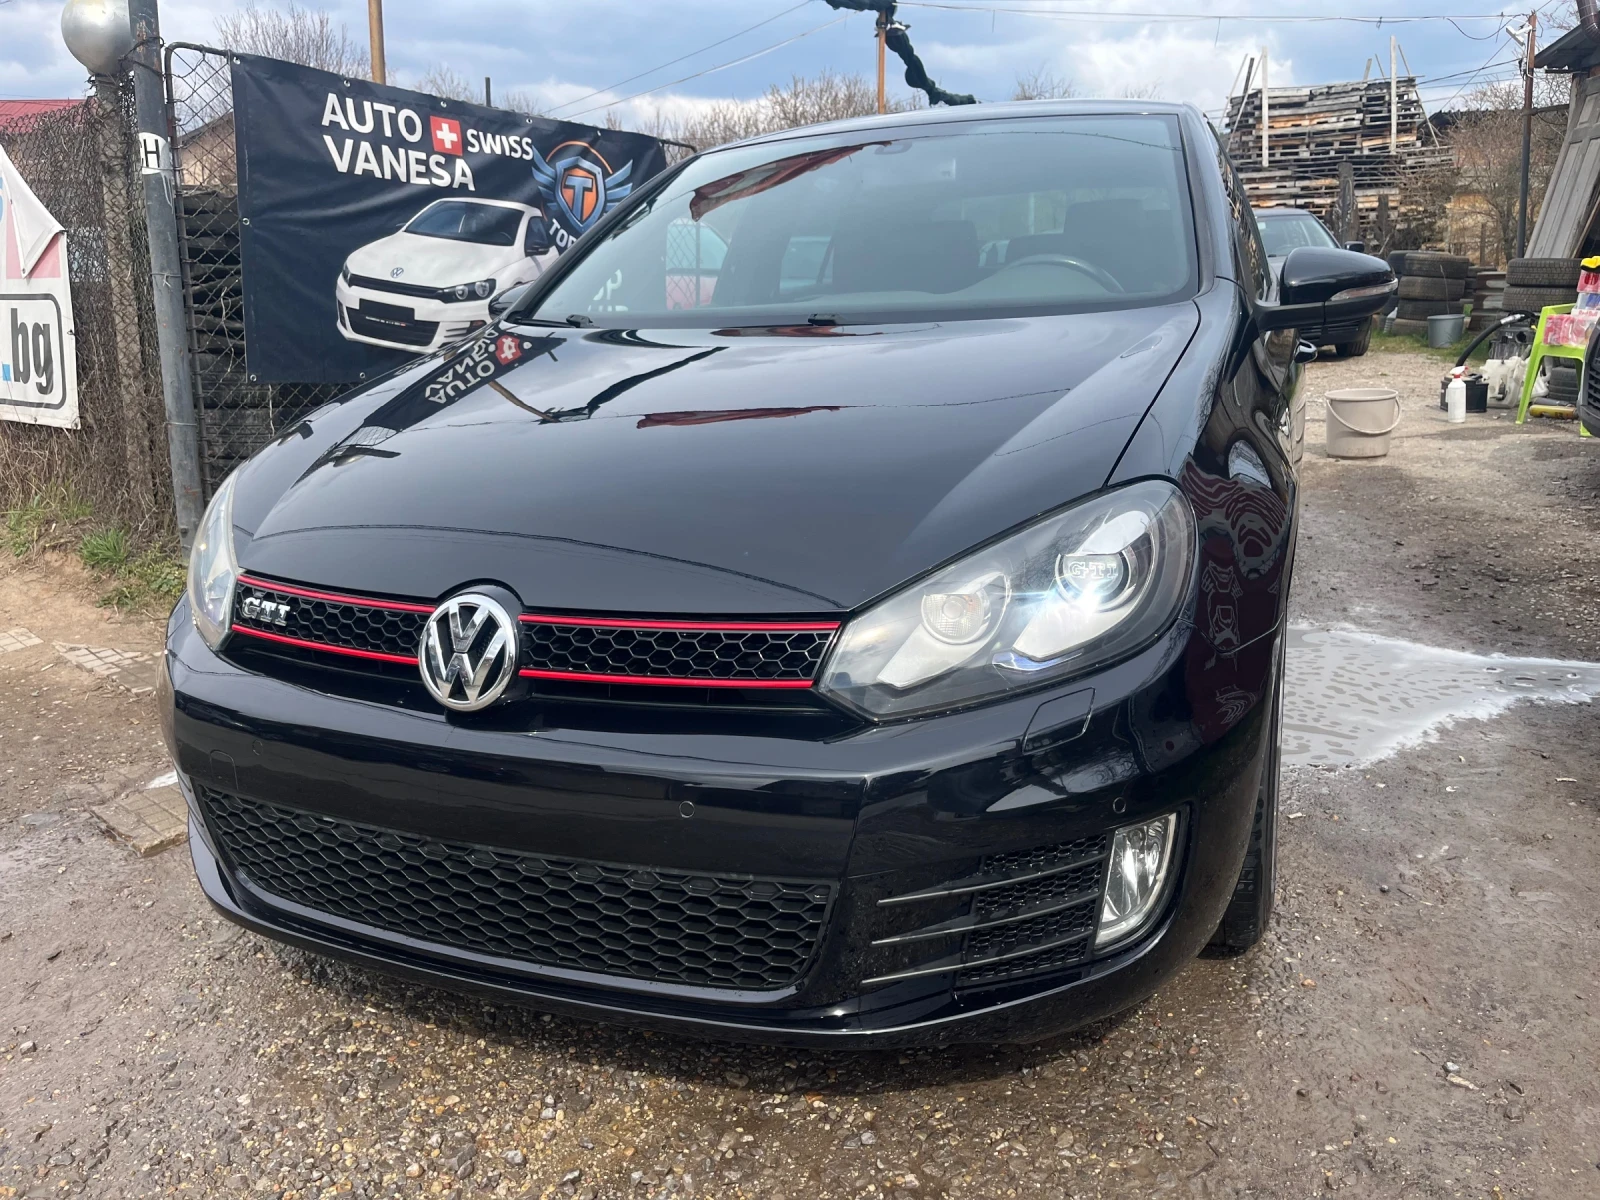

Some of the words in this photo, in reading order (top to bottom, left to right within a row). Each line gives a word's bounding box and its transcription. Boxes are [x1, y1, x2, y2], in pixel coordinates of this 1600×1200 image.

[321, 92, 423, 143] AUTO
[140, 138, 160, 168] H
[466, 128, 534, 161] SWISS
[322, 134, 476, 191] VANESA
[1068, 561, 1119, 579] GTI
[241, 596, 291, 627] GTI
